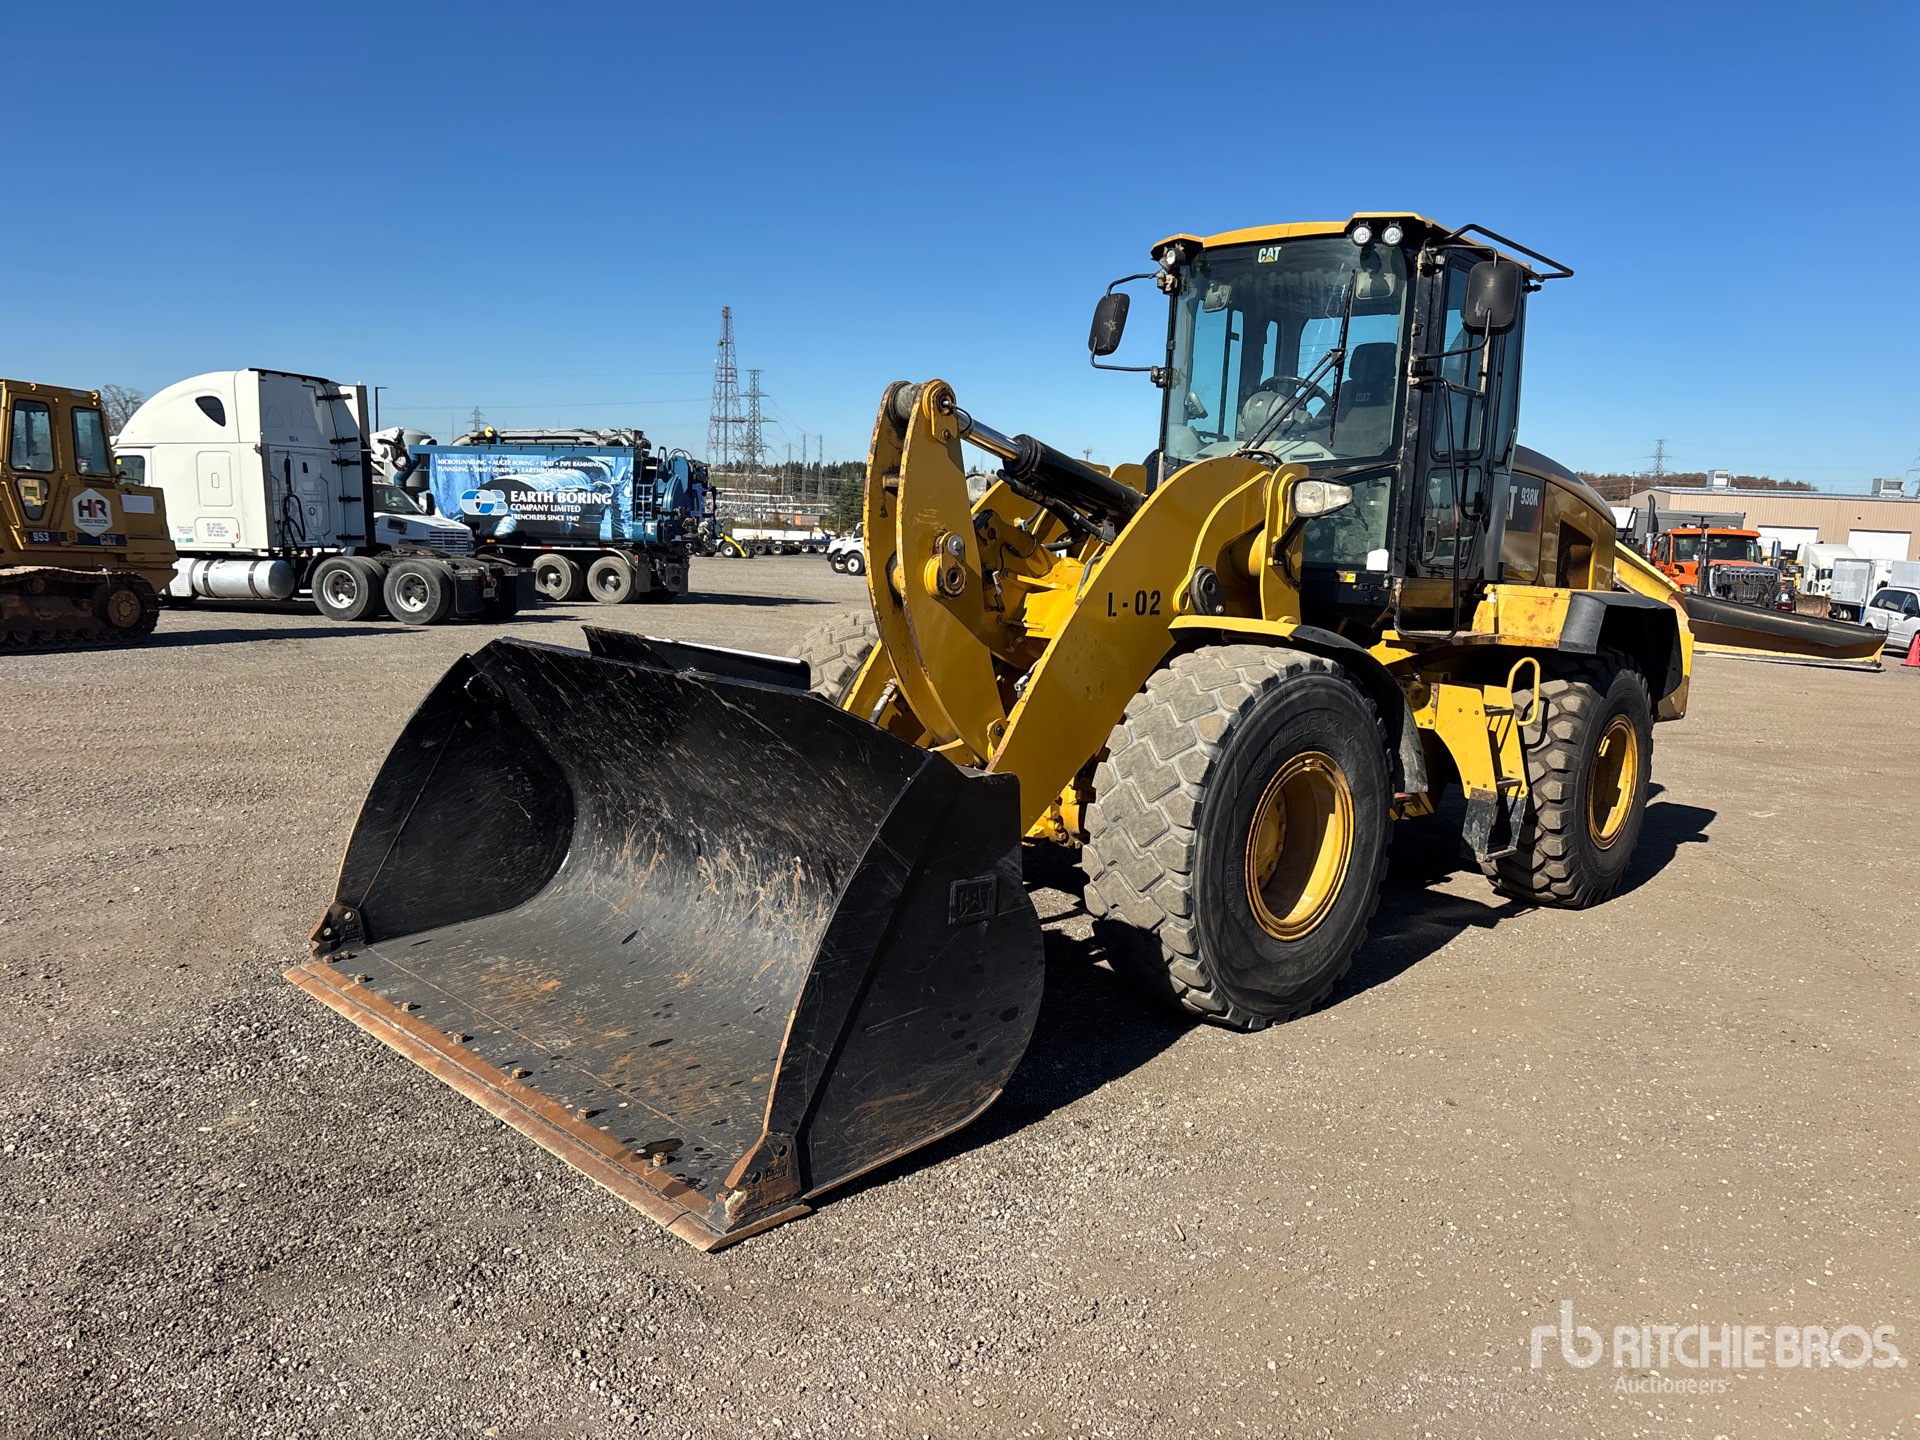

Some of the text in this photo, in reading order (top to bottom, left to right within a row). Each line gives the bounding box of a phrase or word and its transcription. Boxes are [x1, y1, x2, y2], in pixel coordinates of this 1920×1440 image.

[1257, 246, 1282, 264] CAT
[510, 490, 612, 505] EARTH BORING
[1520, 487, 1540, 506] 938K
[78, 499, 108, 518] HR
[510, 503, 582, 513] COMPANY LIMITED
[511, 513, 546, 521] TRENCHLESS
[32, 531, 50, 542] 953
[100, 535, 118, 546] CAT
